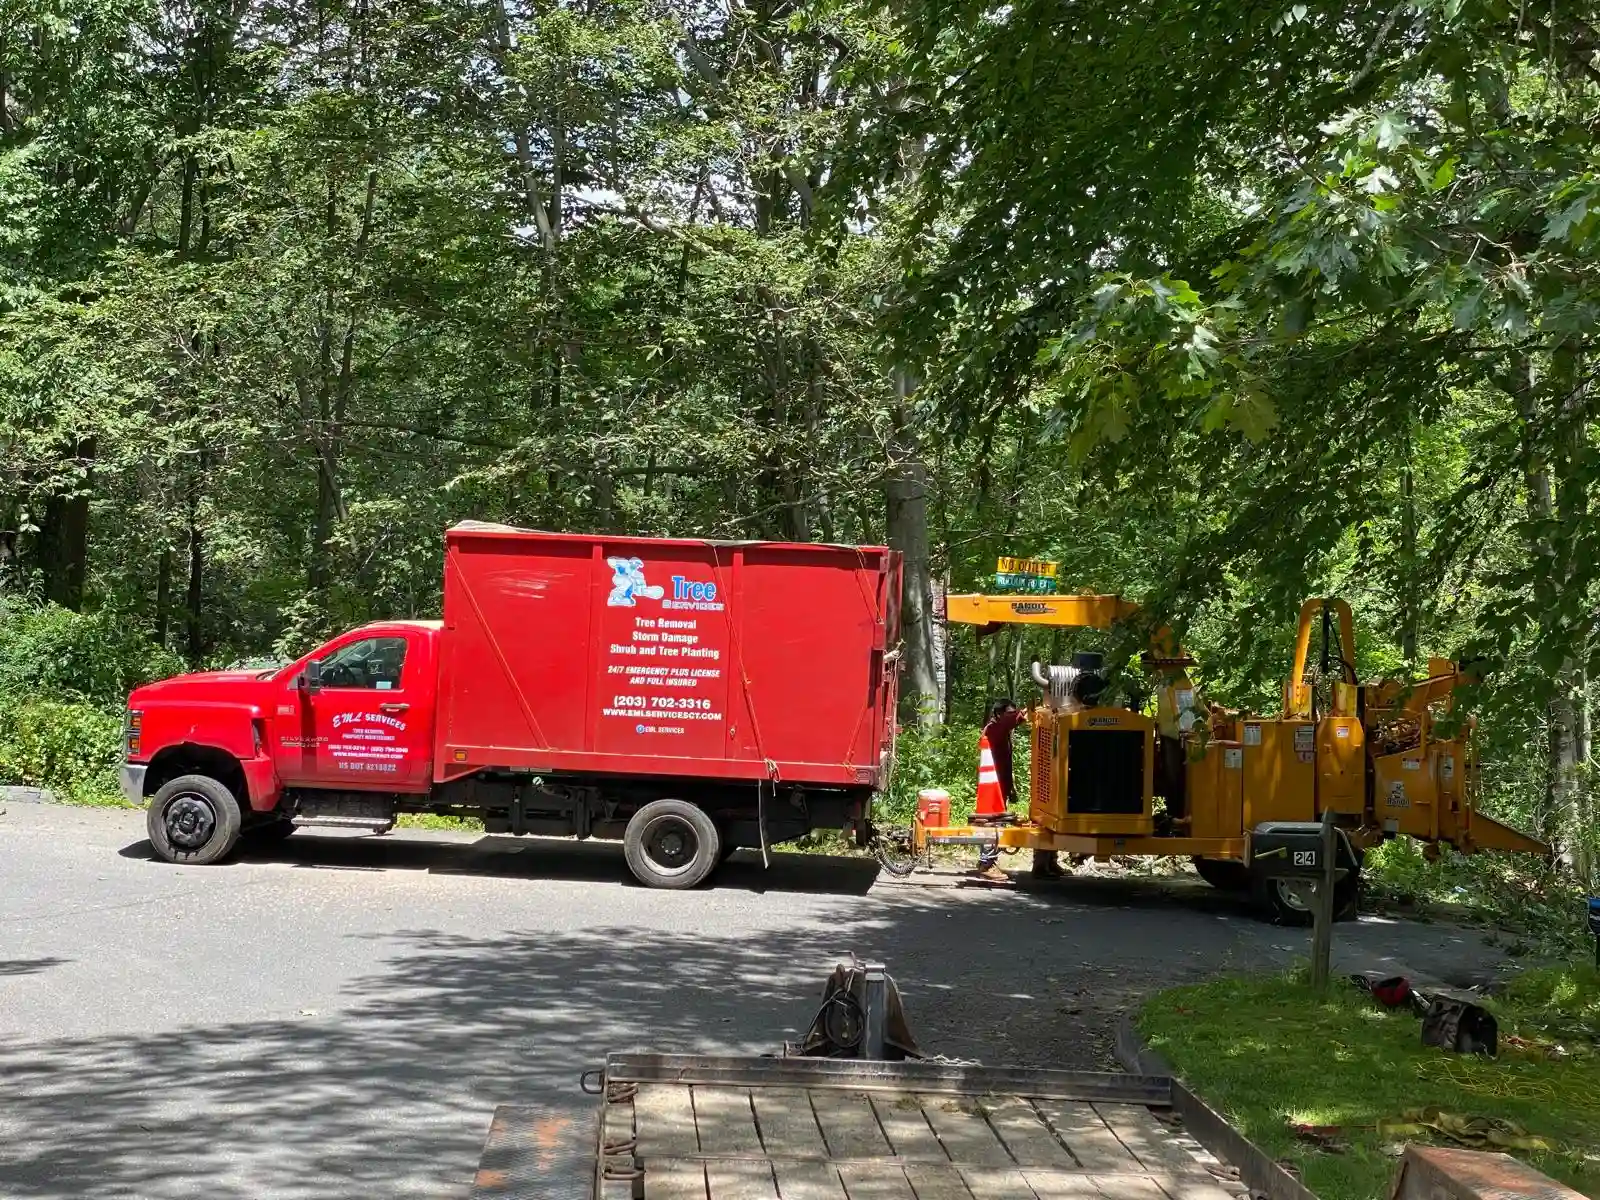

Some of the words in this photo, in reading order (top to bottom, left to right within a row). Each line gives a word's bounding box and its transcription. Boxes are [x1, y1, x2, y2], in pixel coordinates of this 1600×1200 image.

[672, 575, 717, 601] Tree
[635, 617, 655, 628] Tree
[657, 618, 697, 629] Removal
[632, 631, 659, 642] Storm
[661, 632, 699, 645] Damage
[610, 643, 637, 655] Shrub
[639, 646, 656, 656] and
[659, 646, 679, 657] Tree
[681, 647, 720, 660] Planting
[607, 665, 623, 674] 24/7
[625, 666, 669, 676] EMERGENCY
[670, 668, 689, 677] PLUS
[690, 669, 721, 678] LICENSE
[629, 676, 645, 685] AND
[666, 678, 698, 687] INSURED
[613, 695, 646, 709] (203)
[651, 697, 711, 710] 702-3316
[332, 711, 362, 728] EML
[365, 713, 407, 731] SERVICES
[602, 708, 722, 721] WWW.EMLSERVICESCT.COM
[658, 726, 685, 734] SERVICES
[1295, 852, 1314, 865] 24
